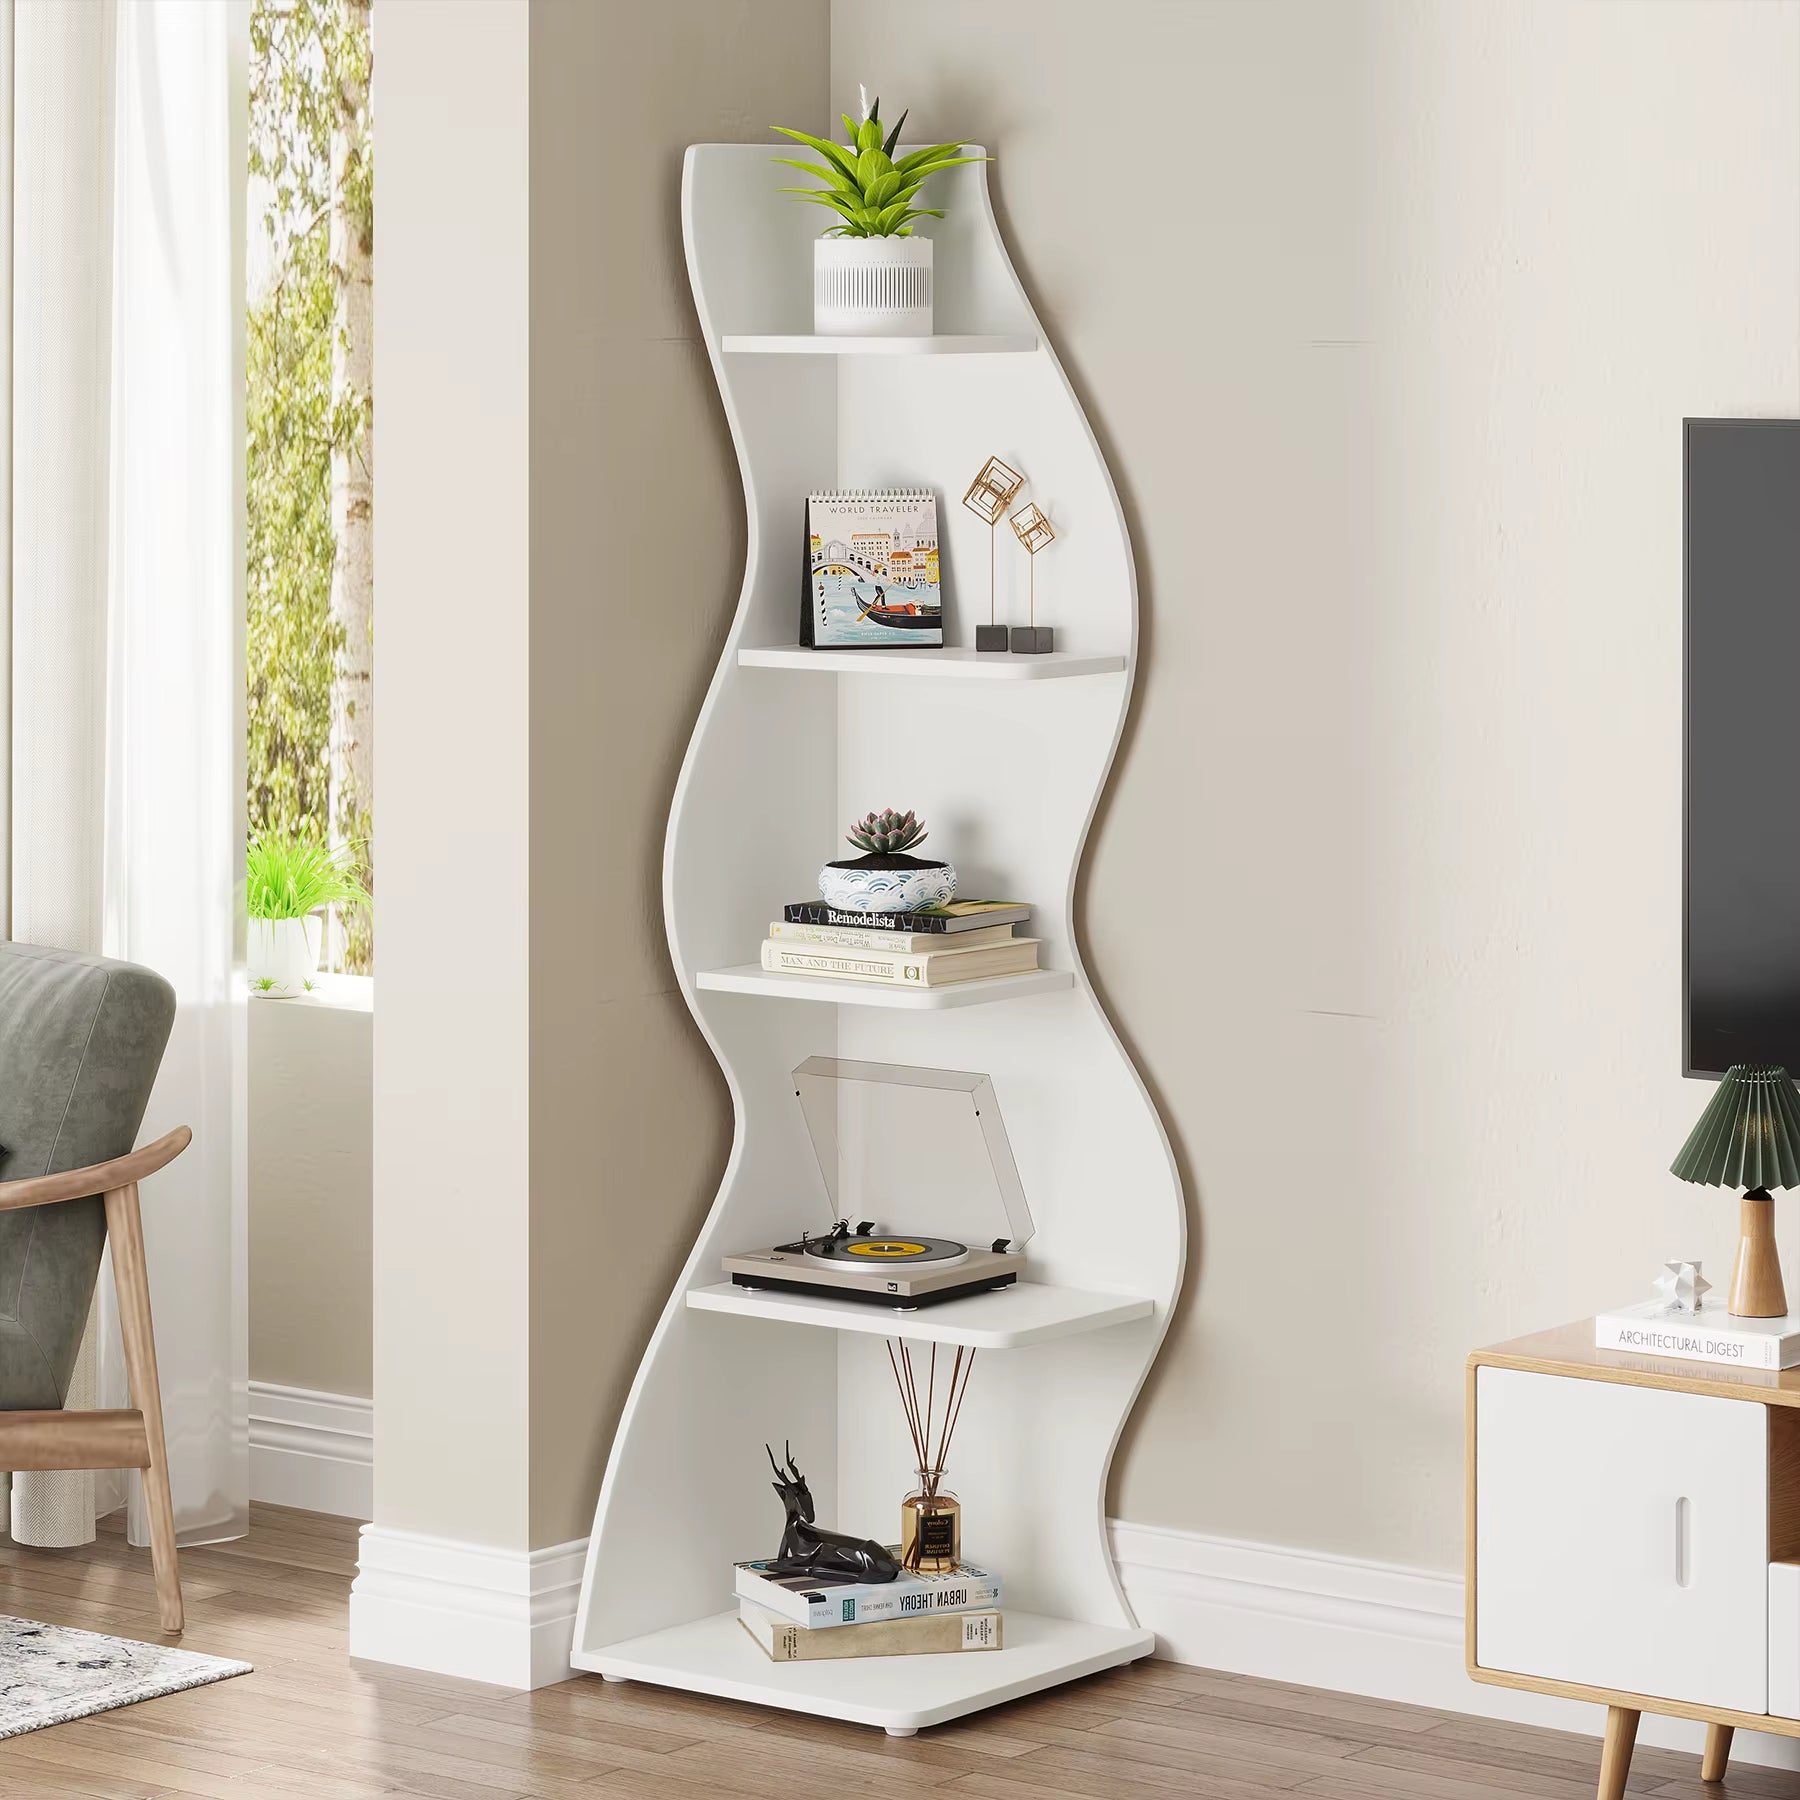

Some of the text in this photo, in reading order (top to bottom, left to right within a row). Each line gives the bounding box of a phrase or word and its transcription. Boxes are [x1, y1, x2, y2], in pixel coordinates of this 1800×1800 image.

[829, 505, 919, 514] WORLD TRAVELER
[827, 909, 896, 928] Remodelista
[781, 956, 803, 965] MAN
[807, 958, 828, 968] AND
[831, 960, 852, 970] THE
[854, 962, 894, 975] FUTURE
[1618, 1330, 1703, 1353] ARCHITECTURAL
[1706, 1341, 1745, 1358] DIGEST
